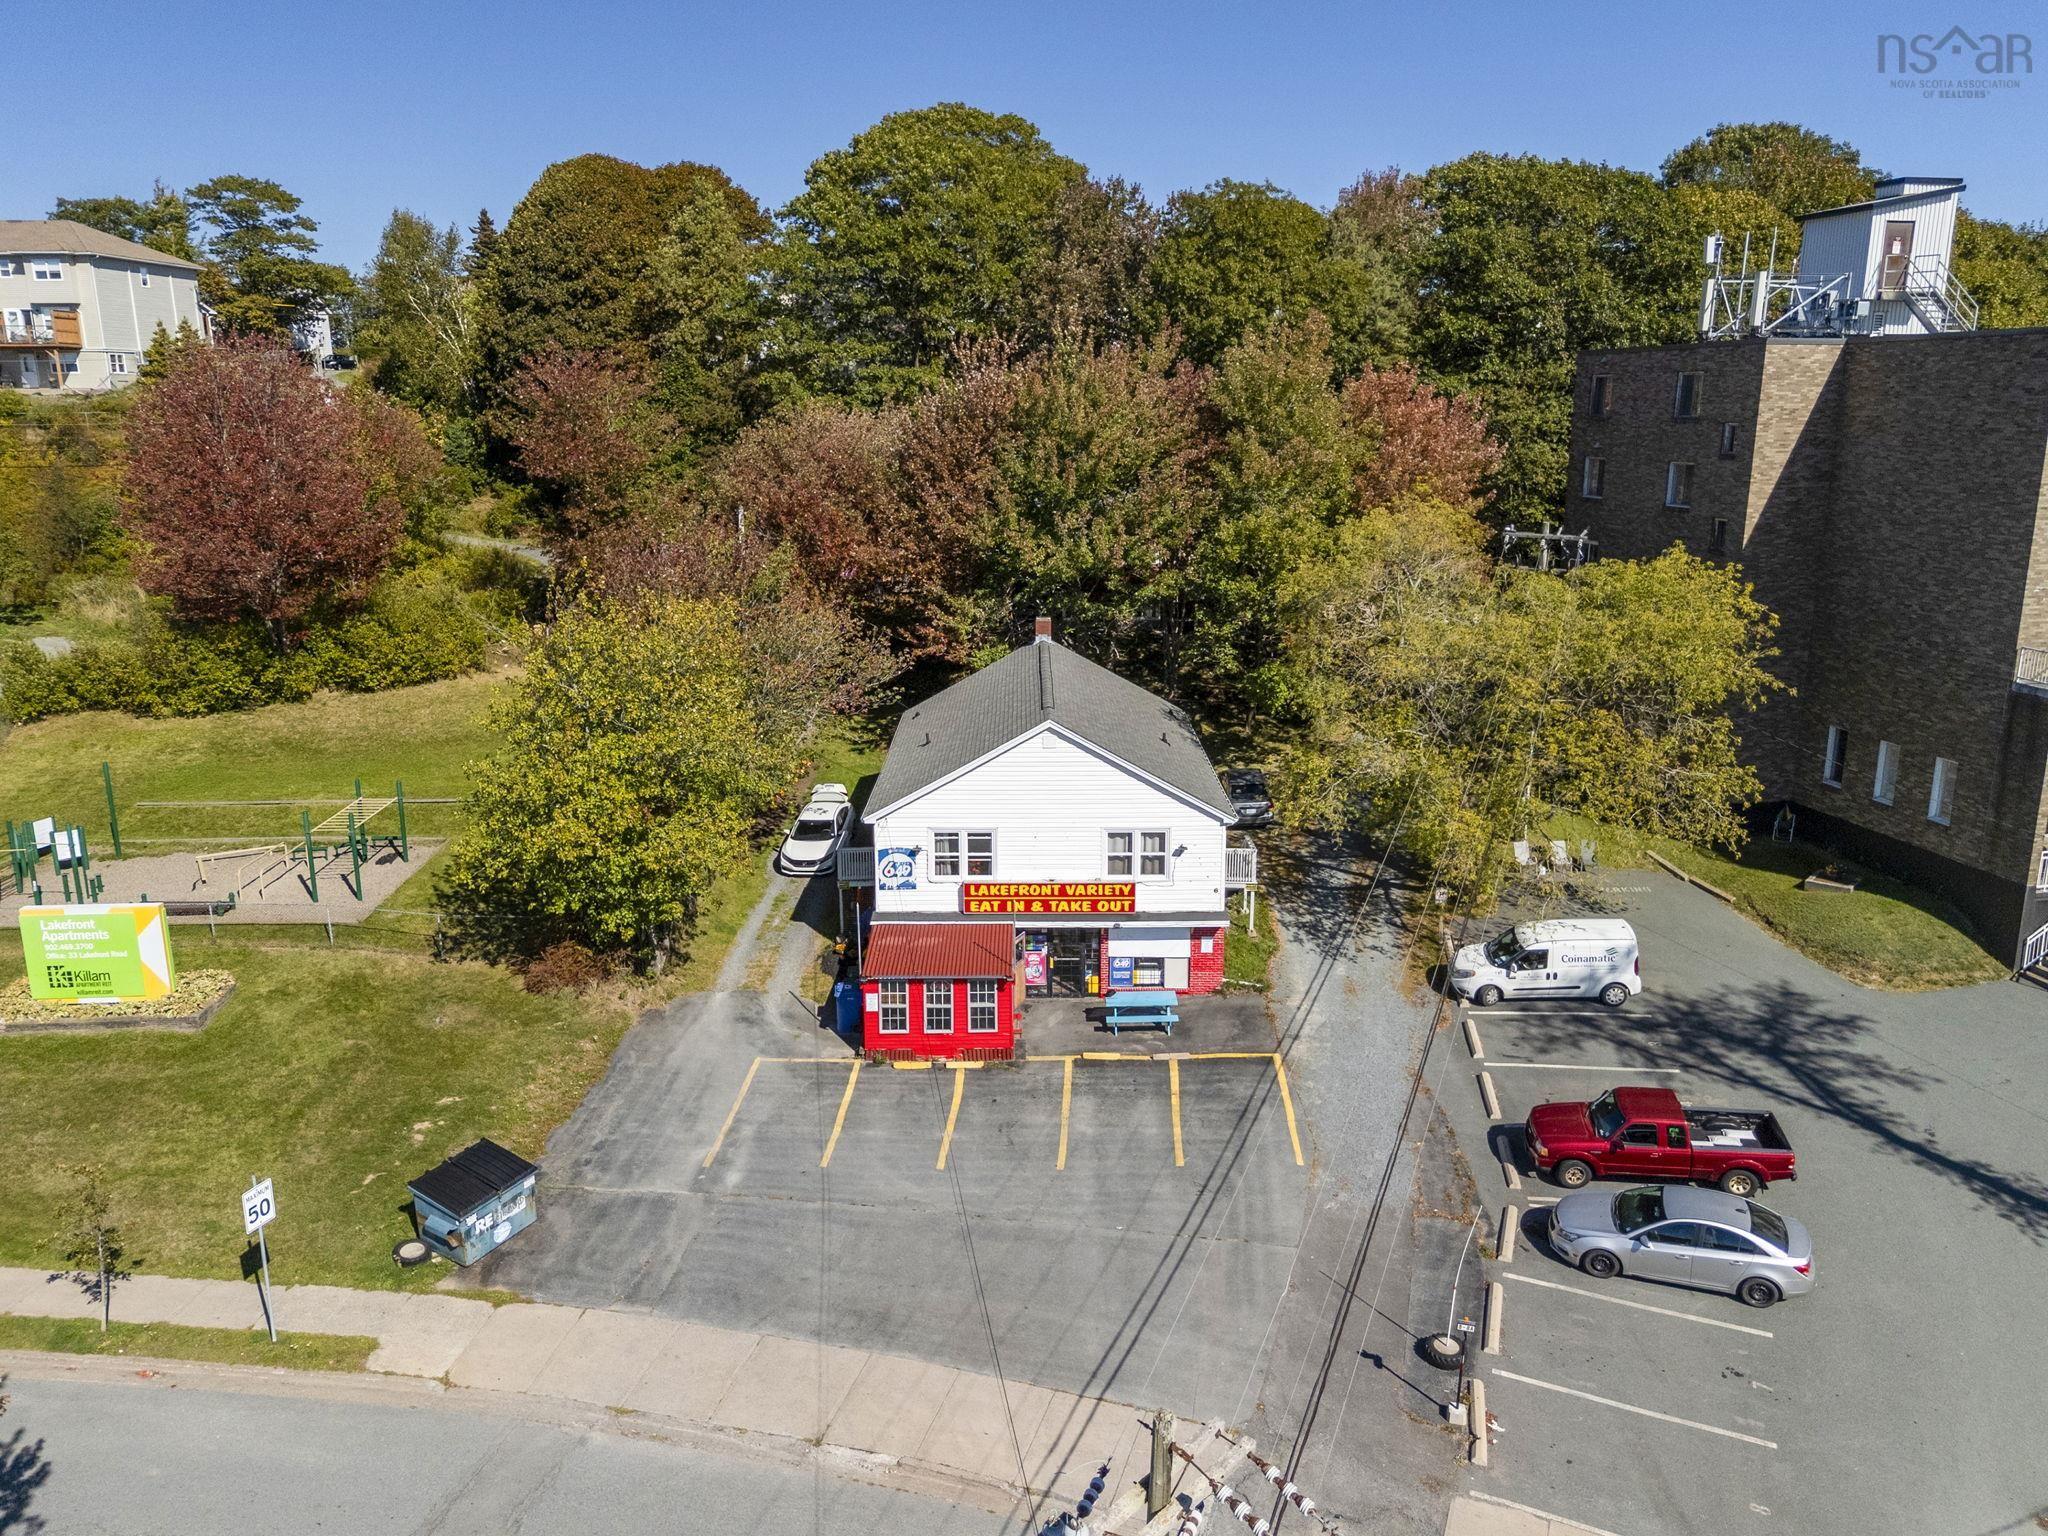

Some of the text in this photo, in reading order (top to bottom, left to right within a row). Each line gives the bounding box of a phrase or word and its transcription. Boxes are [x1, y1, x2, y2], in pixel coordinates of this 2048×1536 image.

[970, 884, 1132, 896] LAKEFRONT VARIETY
[970, 900, 1132, 912] EAT IN & TAKE OUT
[40, 920, 96, 931] Lakefront
[42, 930, 110, 943] Apartments
[1561, 955, 1615, 963] Coinamatic
[73, 970, 111, 981] Killam
[248, 1198, 271, 1224] 50
